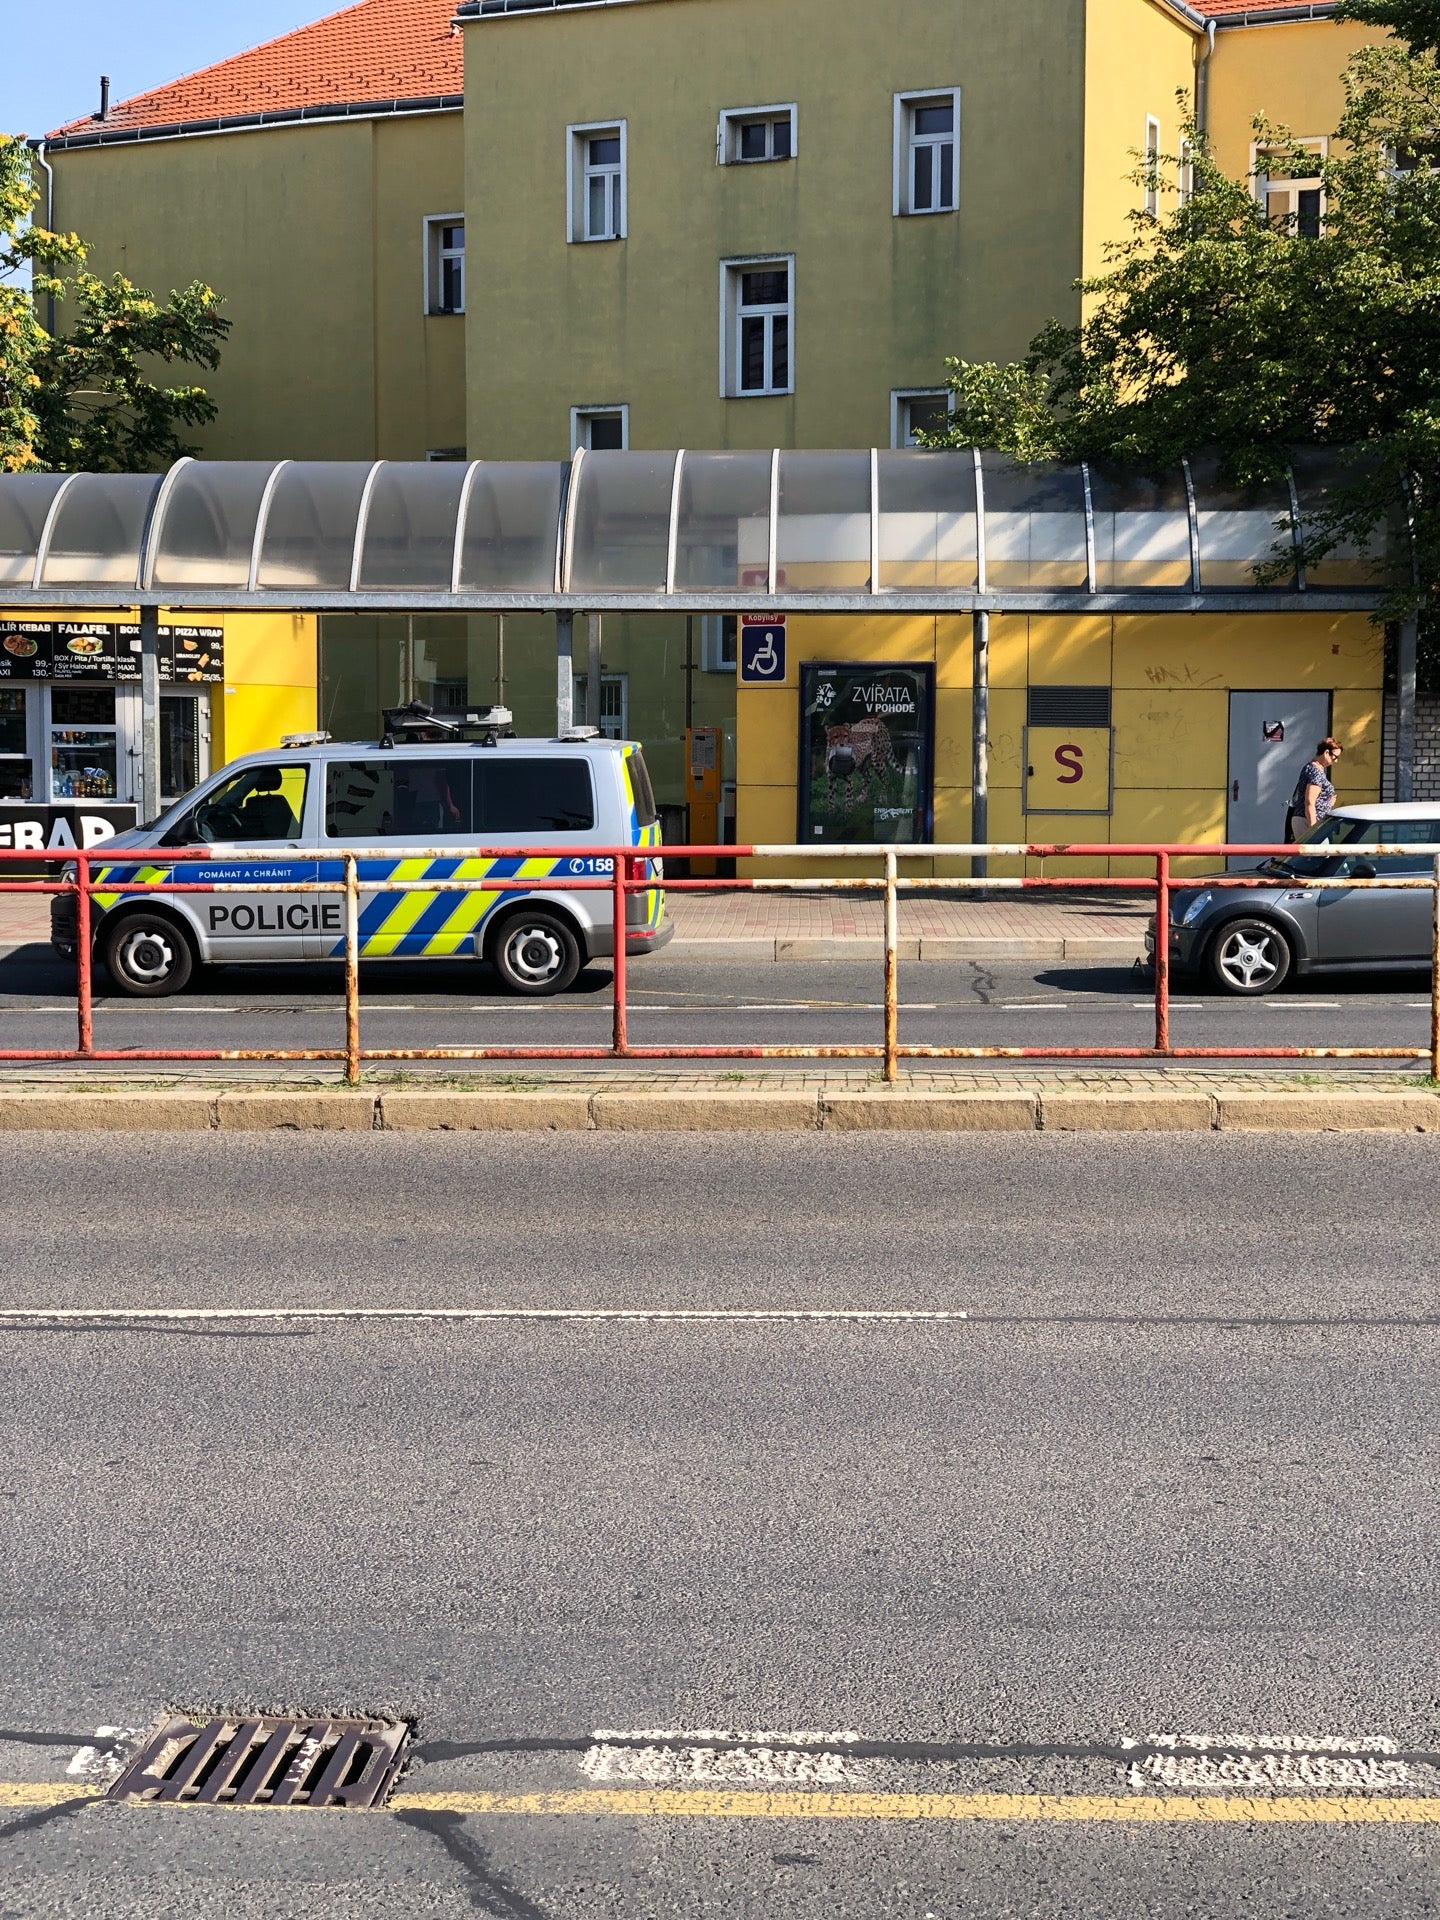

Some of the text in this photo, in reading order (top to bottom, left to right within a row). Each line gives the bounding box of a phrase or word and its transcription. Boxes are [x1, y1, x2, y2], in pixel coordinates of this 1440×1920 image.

[0, 621, 51, 632] LÍŘ KEBAB
[58, 624, 111, 635] FALAFEL
[119, 625, 140, 634] BOX
[175, 628, 198, 636] PIZZA
[199, 628, 223, 638] WRAP
[210, 642, 224, 650] 99,-
[35, 660, 52, 668] 99,-
[32, 669, 52, 677] 130,-
[117, 672, 141, 680] Special
[852, 683, 911, 702] ZVÍŘATA
[866, 702, 916, 713] V POHODĚ
[1054, 744, 1083, 784] S
[586, 858, 614, 872] 158
[198, 869, 293, 879] POMÁHAT A CHRÁNIT
[209, 904, 341, 931] POLICIE
